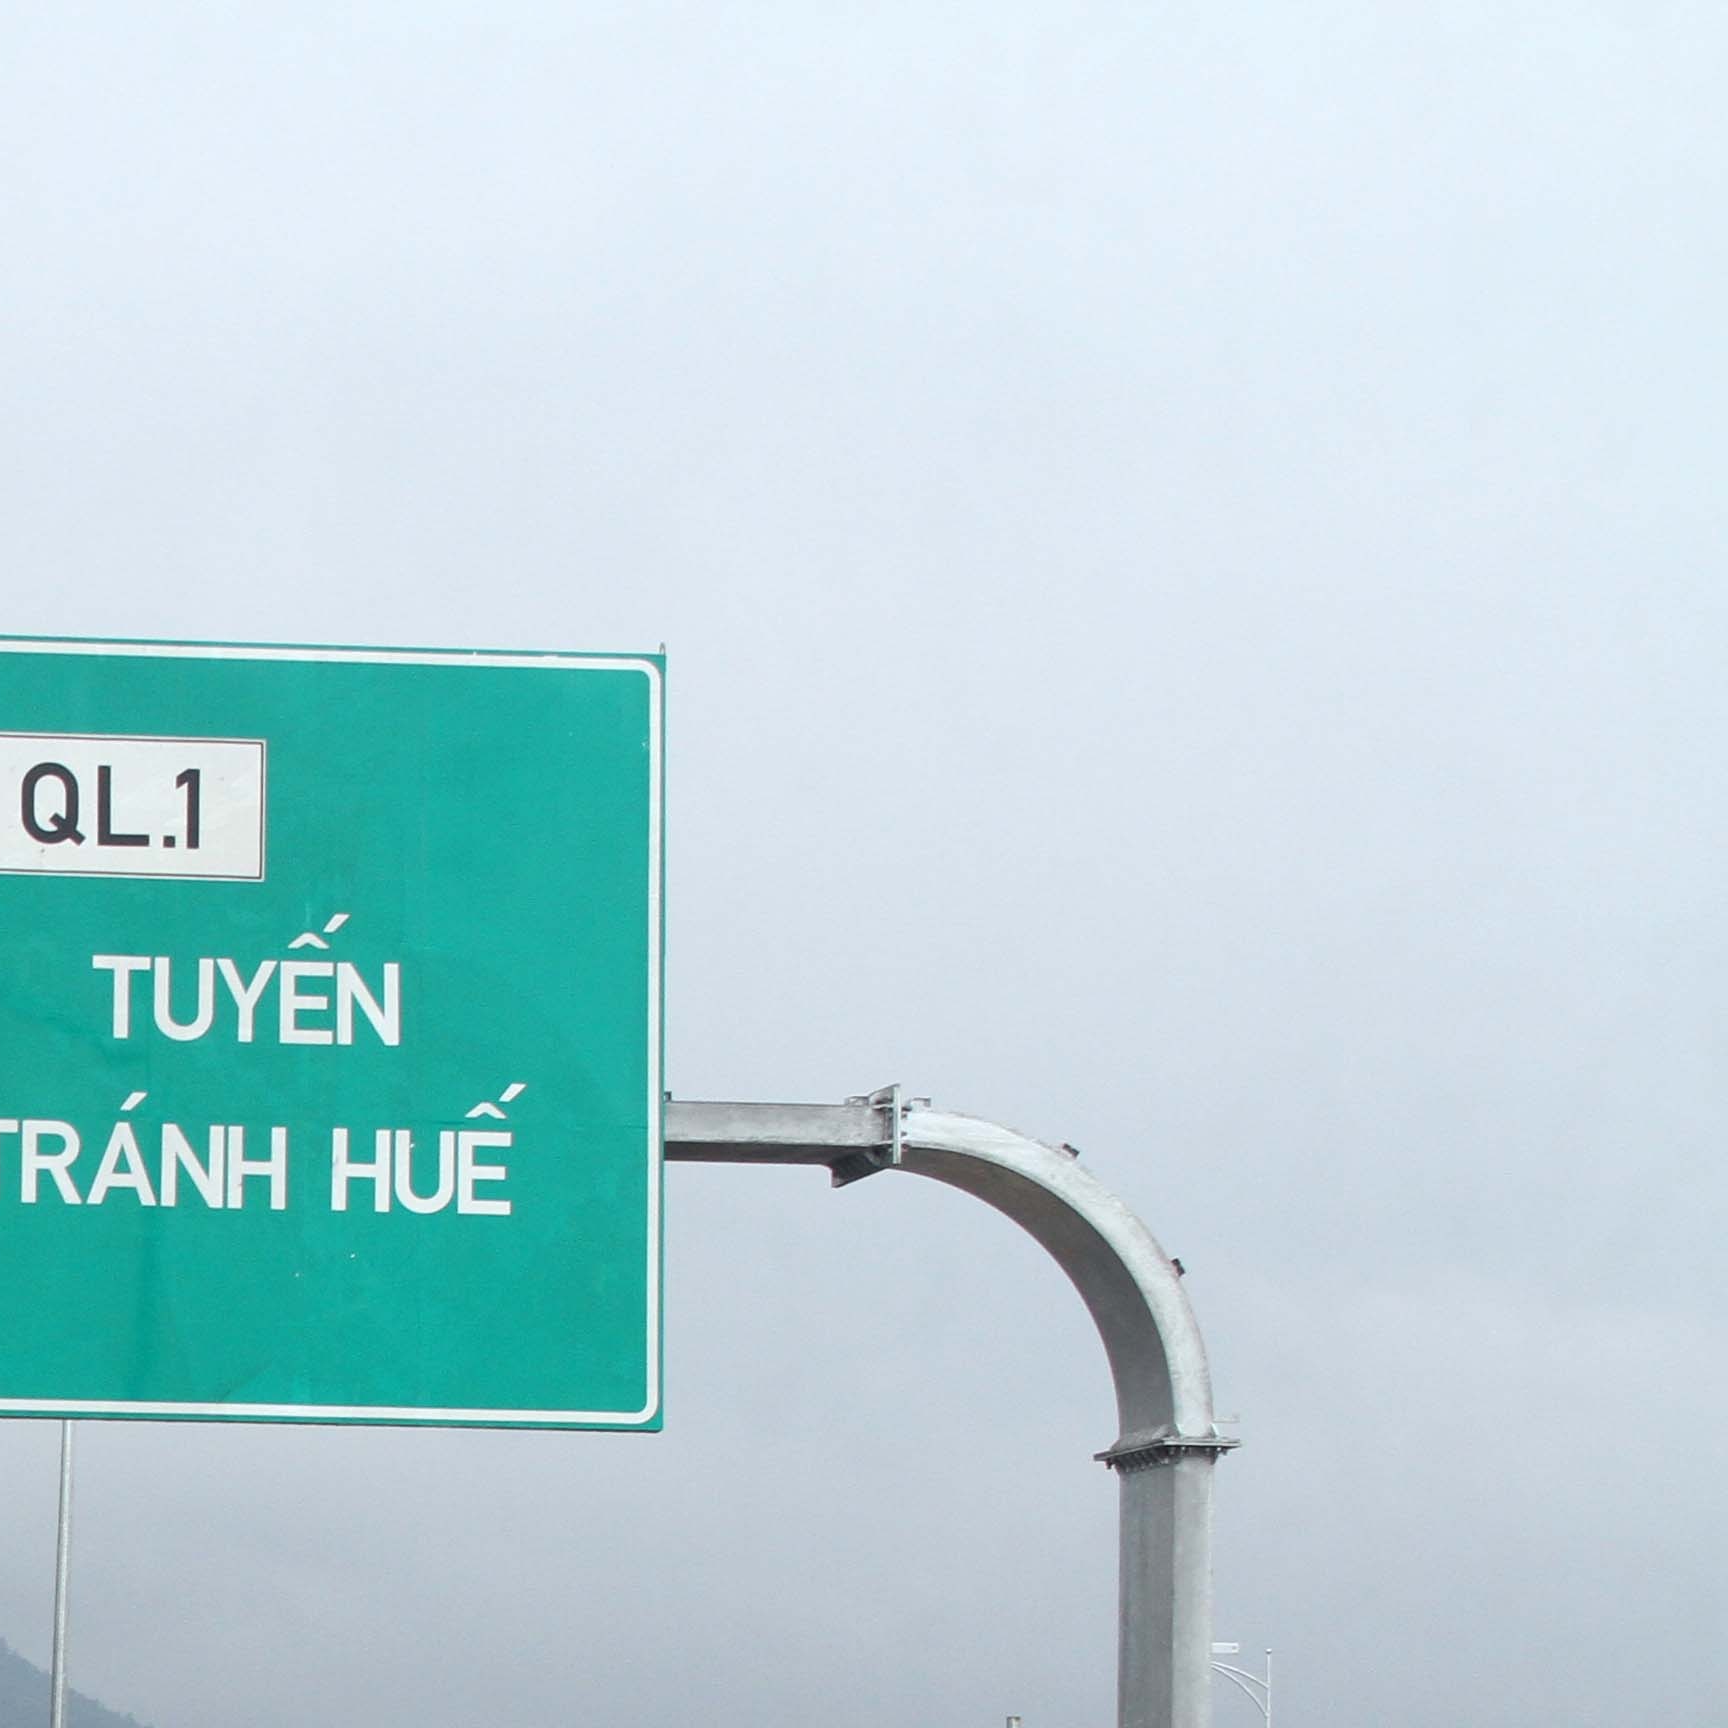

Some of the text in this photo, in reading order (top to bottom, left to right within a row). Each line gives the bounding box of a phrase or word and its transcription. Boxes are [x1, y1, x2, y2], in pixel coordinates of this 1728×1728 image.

[20, 762, 201, 849] QL.1
[92, 913, 401, 1046] TUYẾN
[331, 1083, 527, 1216] HUẾ
